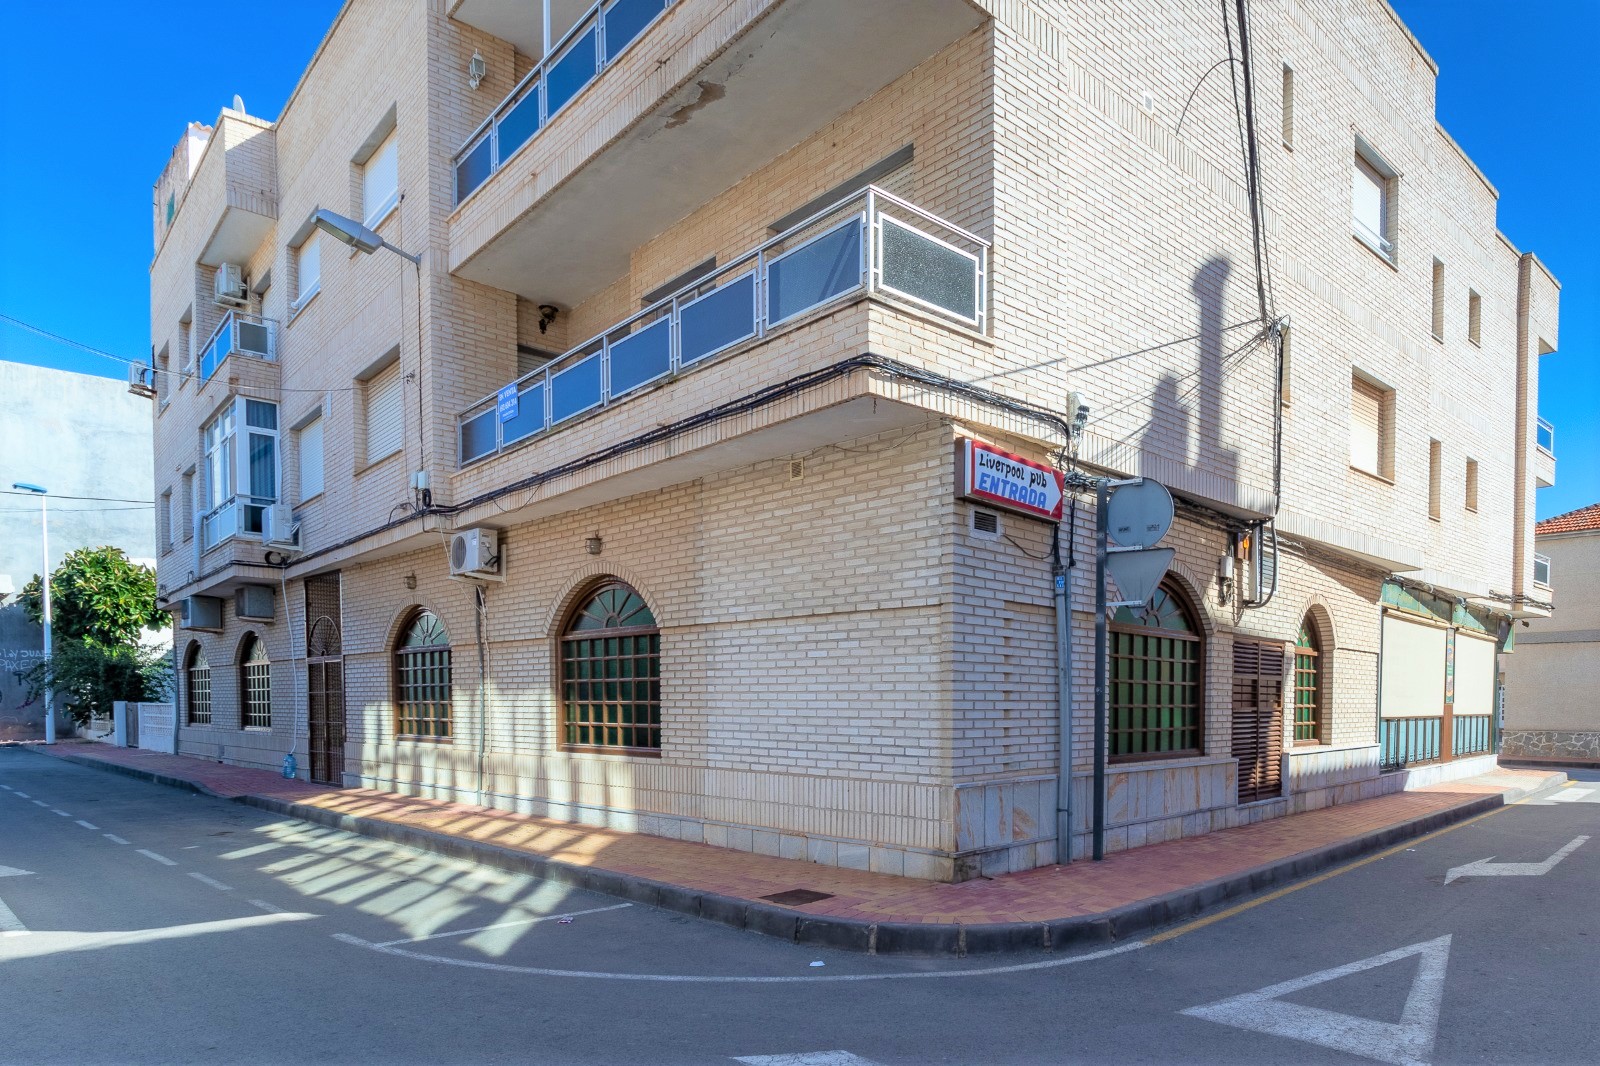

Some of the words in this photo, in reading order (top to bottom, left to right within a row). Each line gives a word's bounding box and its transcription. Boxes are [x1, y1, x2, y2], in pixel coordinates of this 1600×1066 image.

[504, 386, 517, 398] VENTA
[979, 453, 1025, 480] Liverpool
[1029, 471, 1047, 488] pub
[979, 472, 1047, 509] ENTRADA
